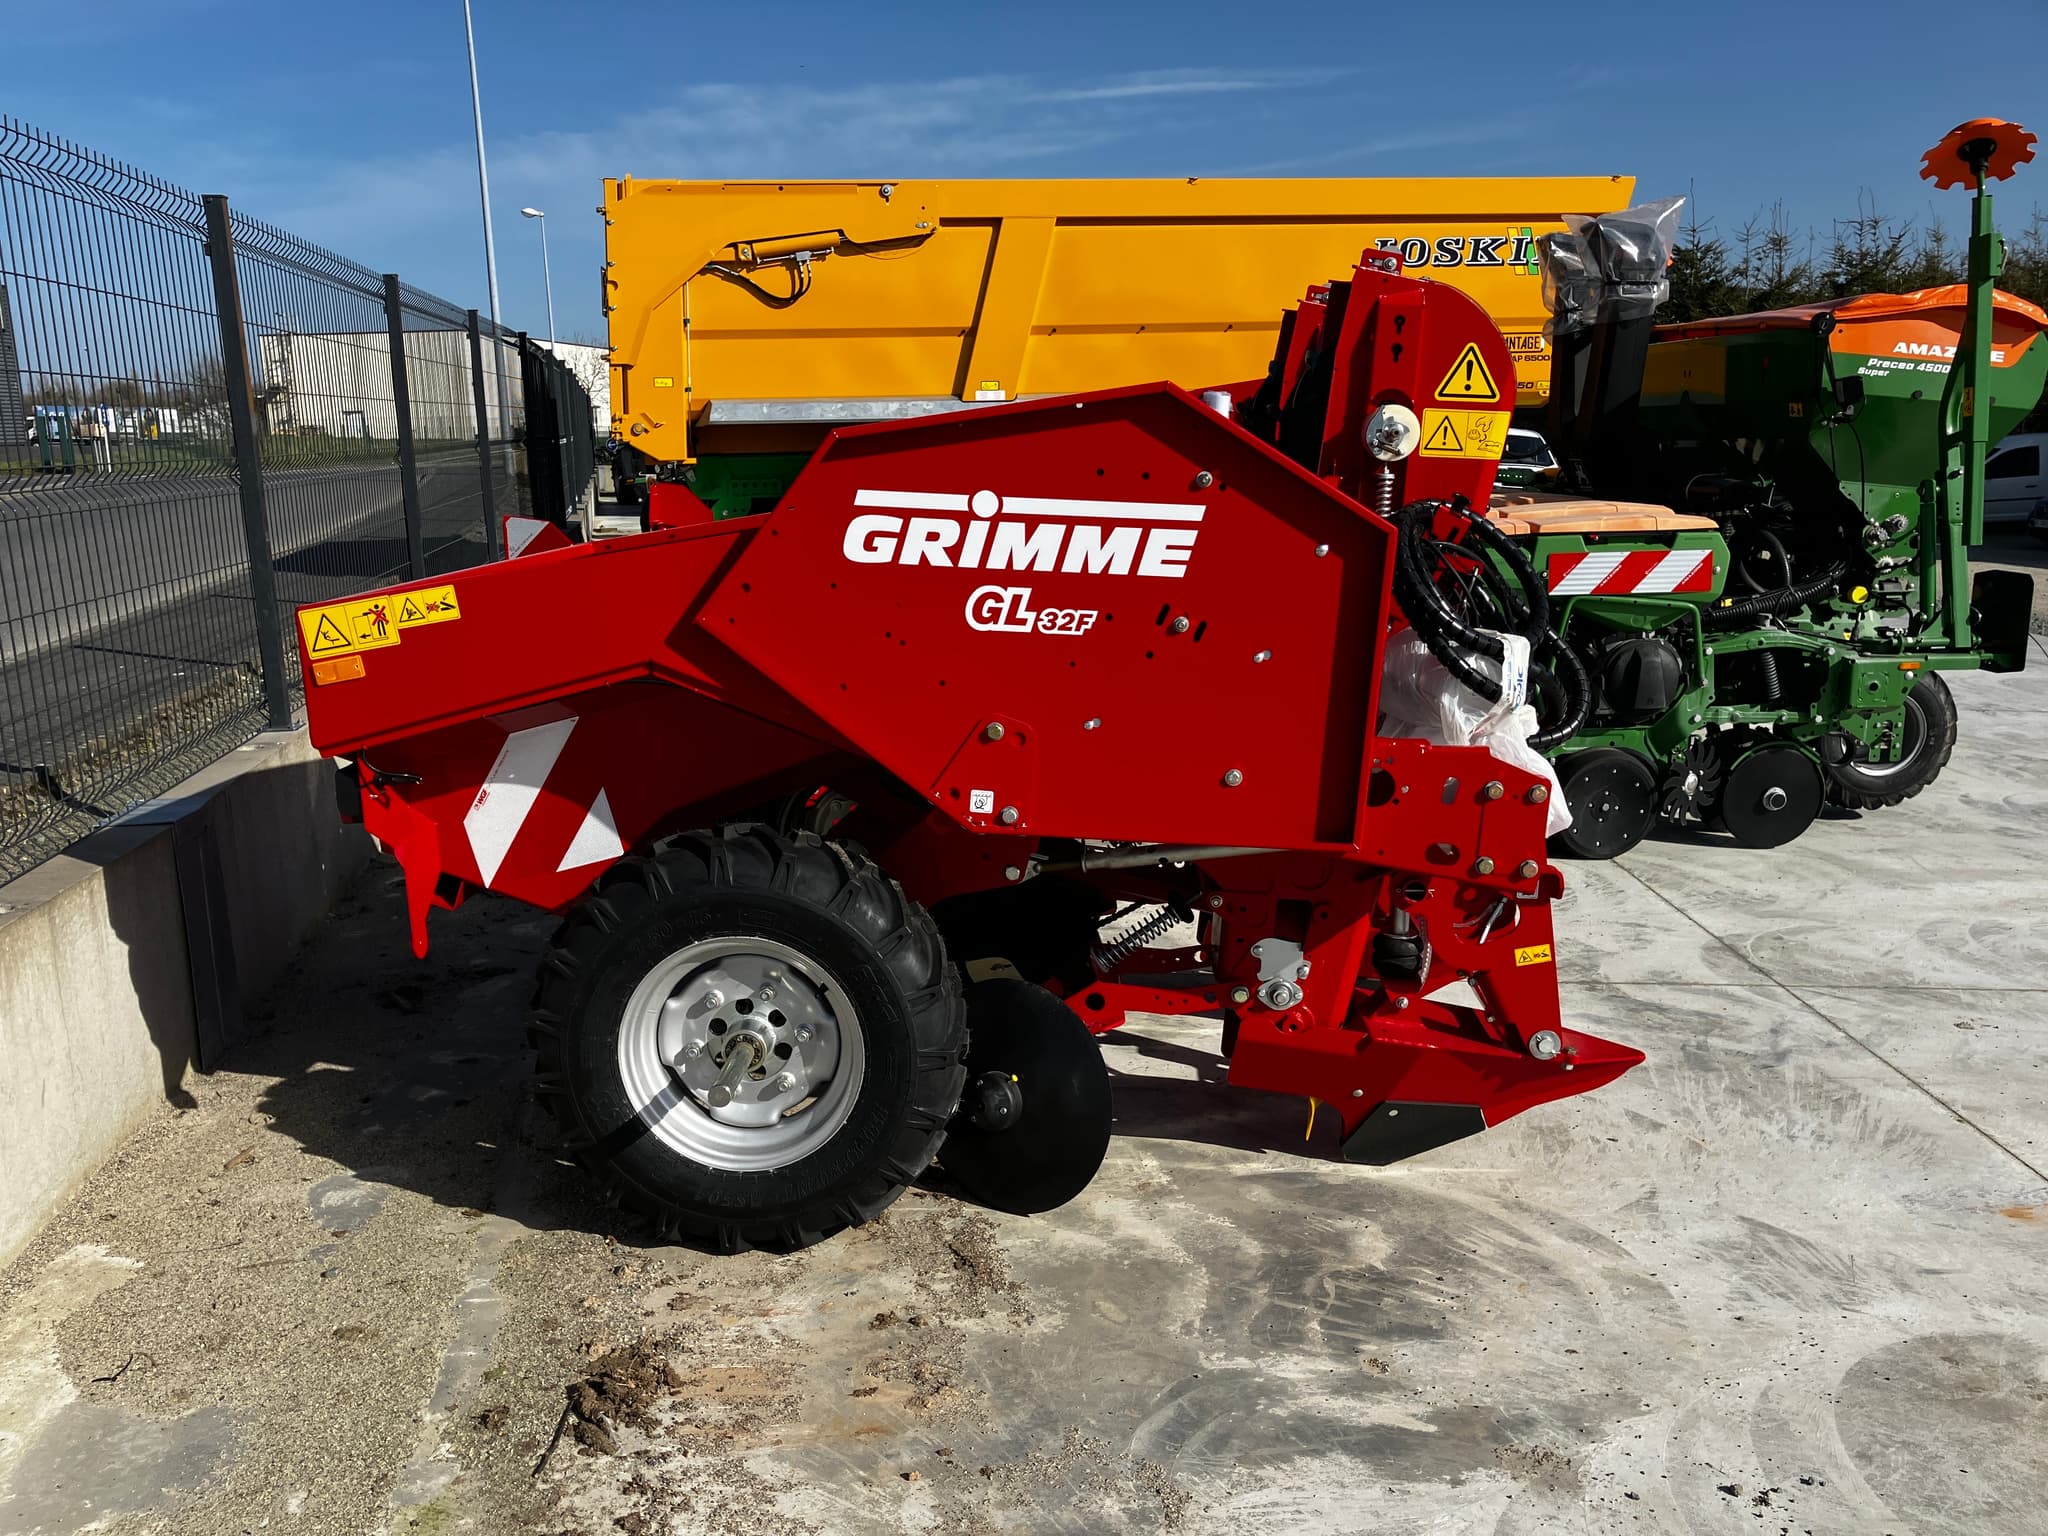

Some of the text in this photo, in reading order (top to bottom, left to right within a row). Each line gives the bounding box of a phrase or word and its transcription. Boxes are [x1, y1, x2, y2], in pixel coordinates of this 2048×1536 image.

[1375, 237, 1540, 267] OSKI
[1525, 354, 1550, 362] 6500
[1893, 341, 2005, 363] AMAZE
[1857, 366, 1890, 377] Super
[1917, 362, 1951, 374] 4500
[965, 585, 1098, 635] GL 32F
